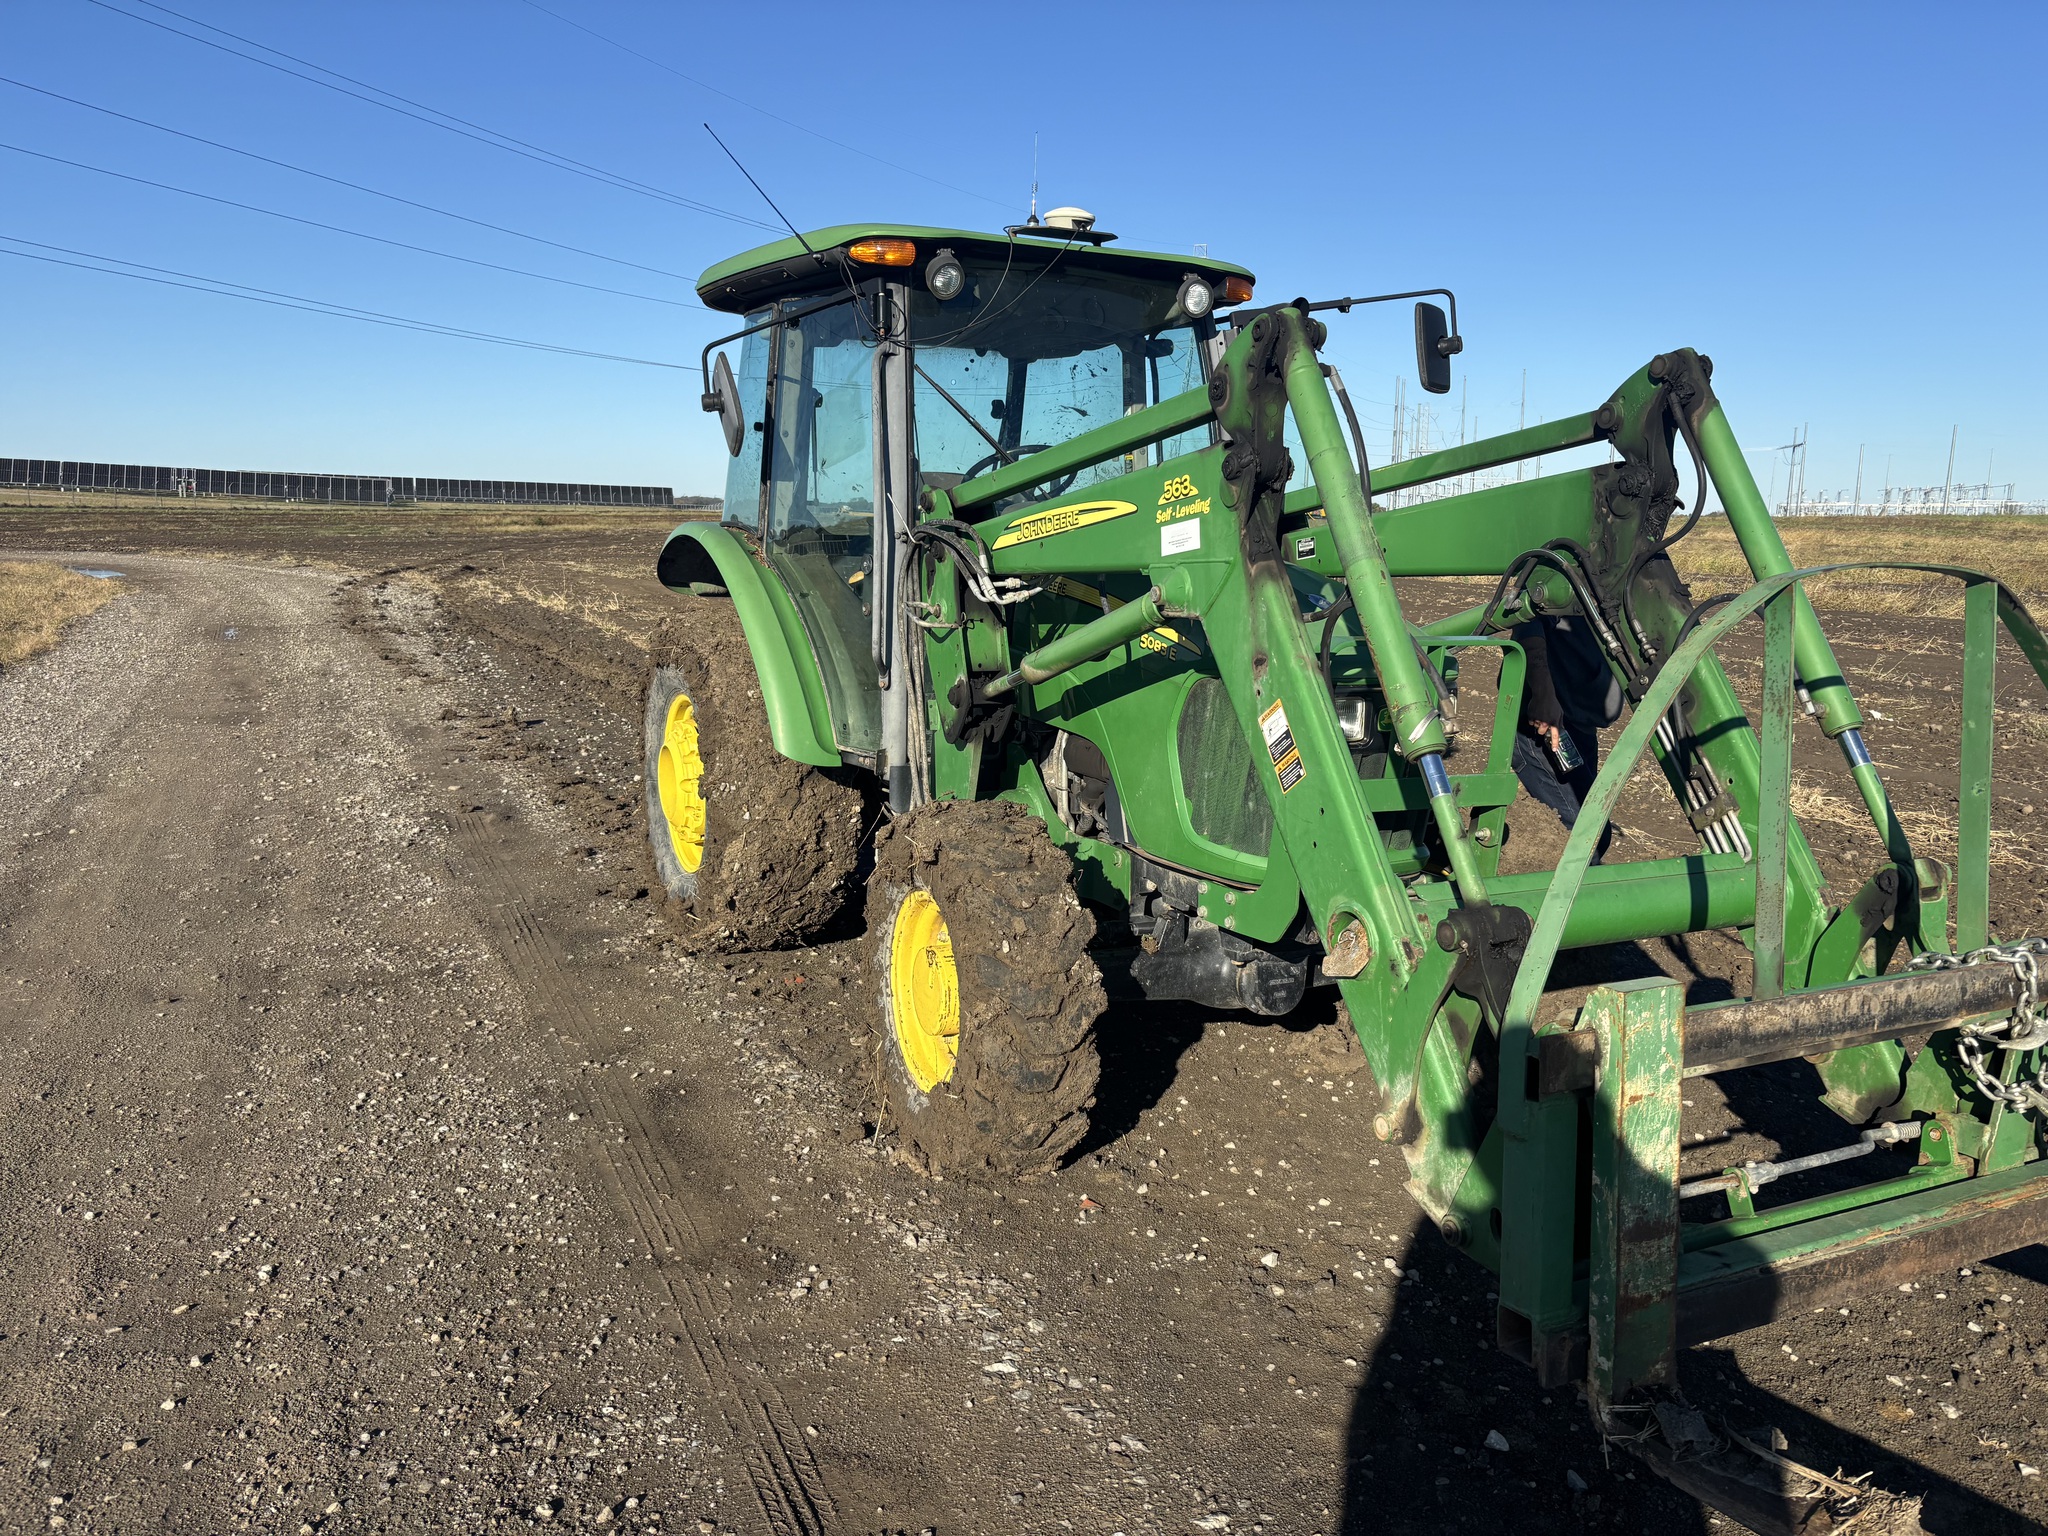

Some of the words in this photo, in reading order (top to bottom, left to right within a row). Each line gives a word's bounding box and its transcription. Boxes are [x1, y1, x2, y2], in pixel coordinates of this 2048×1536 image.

[1164, 474, 1191, 501] 563
[1017, 518, 1047, 541] JOHN
[1044, 509, 1080, 533] DEERE
[1139, 633, 1168, 656] 5083
[1168, 646, 1178, 662] E
